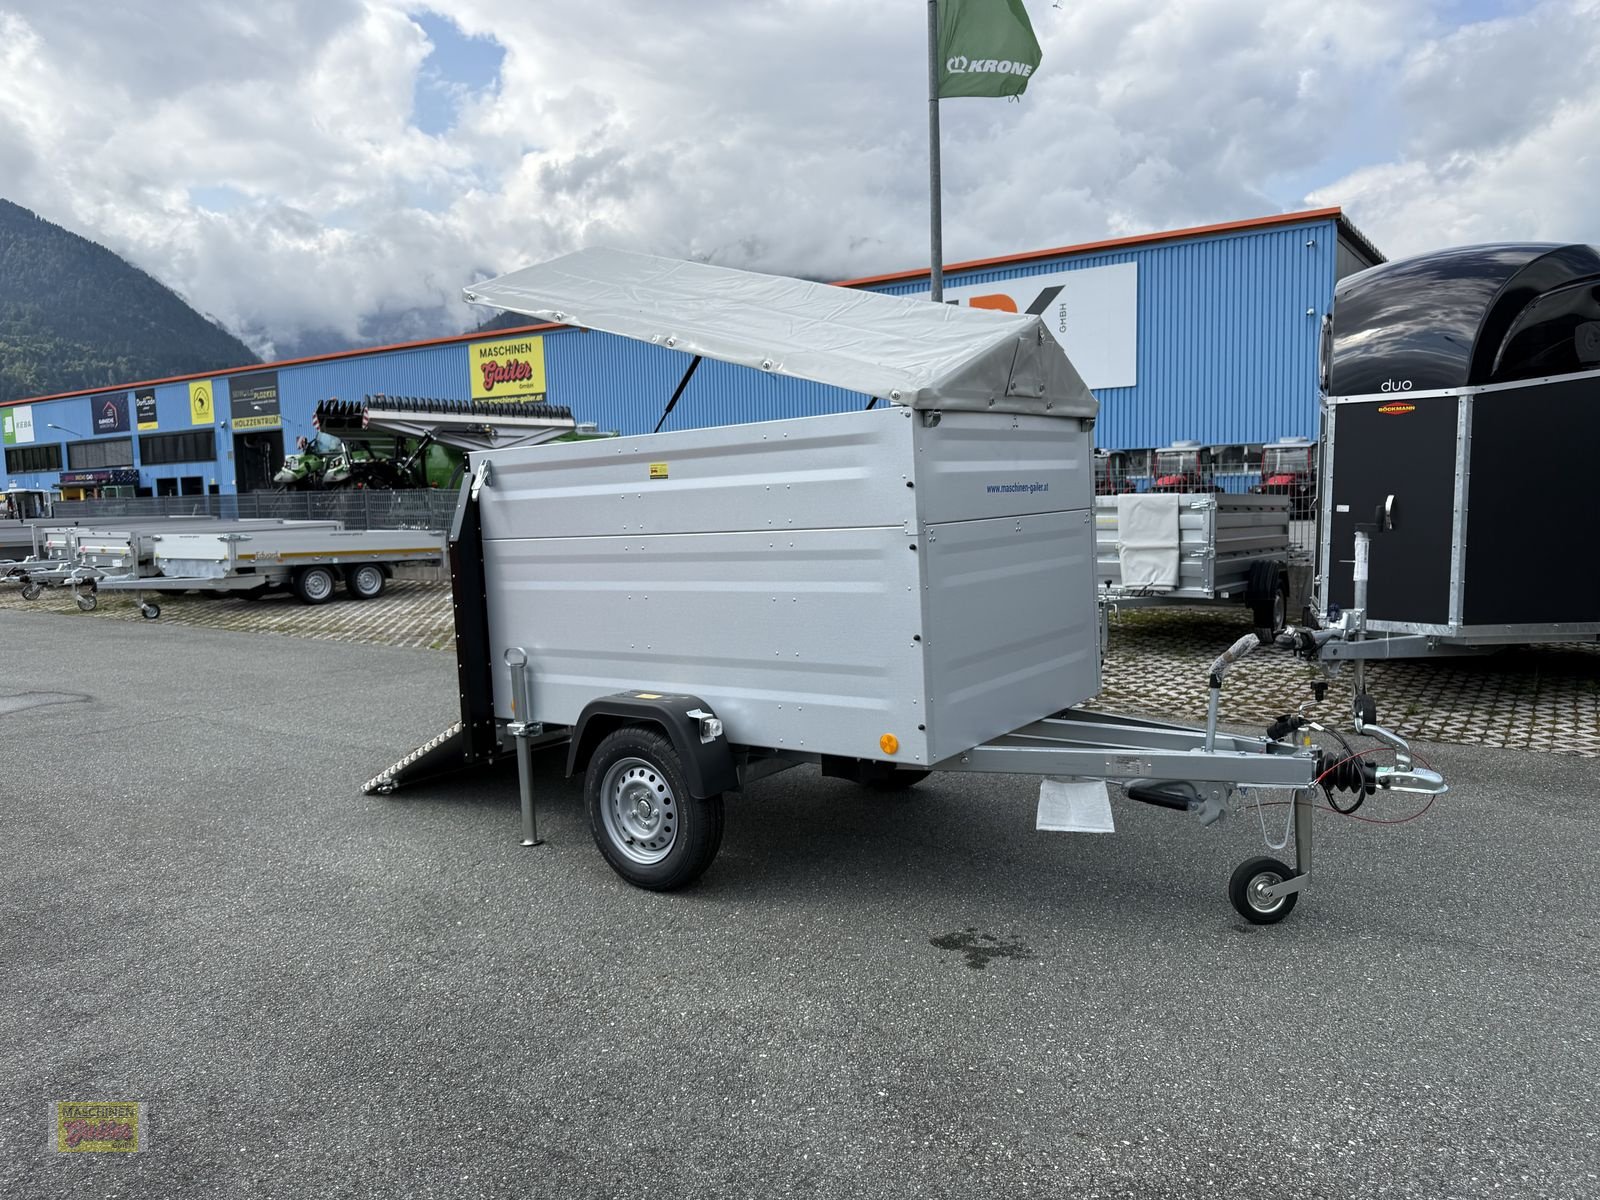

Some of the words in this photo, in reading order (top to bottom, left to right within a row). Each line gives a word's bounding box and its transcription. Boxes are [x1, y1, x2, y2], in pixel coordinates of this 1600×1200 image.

[968, 59, 1033, 77] KRONE
[1059, 303, 1067, 333] GMBH
[480, 342, 532, 358] MASCHINEN
[481, 359, 533, 391] Gailer
[1381, 379, 1413, 392] duo
[1378, 405, 1416, 413] BÖCKMANN
[15, 420, 32, 429] KEBA
[234, 416, 279, 428] HOLZZENTRUM
[986, 482, 1049, 494] www.maschinen-gailer.at
